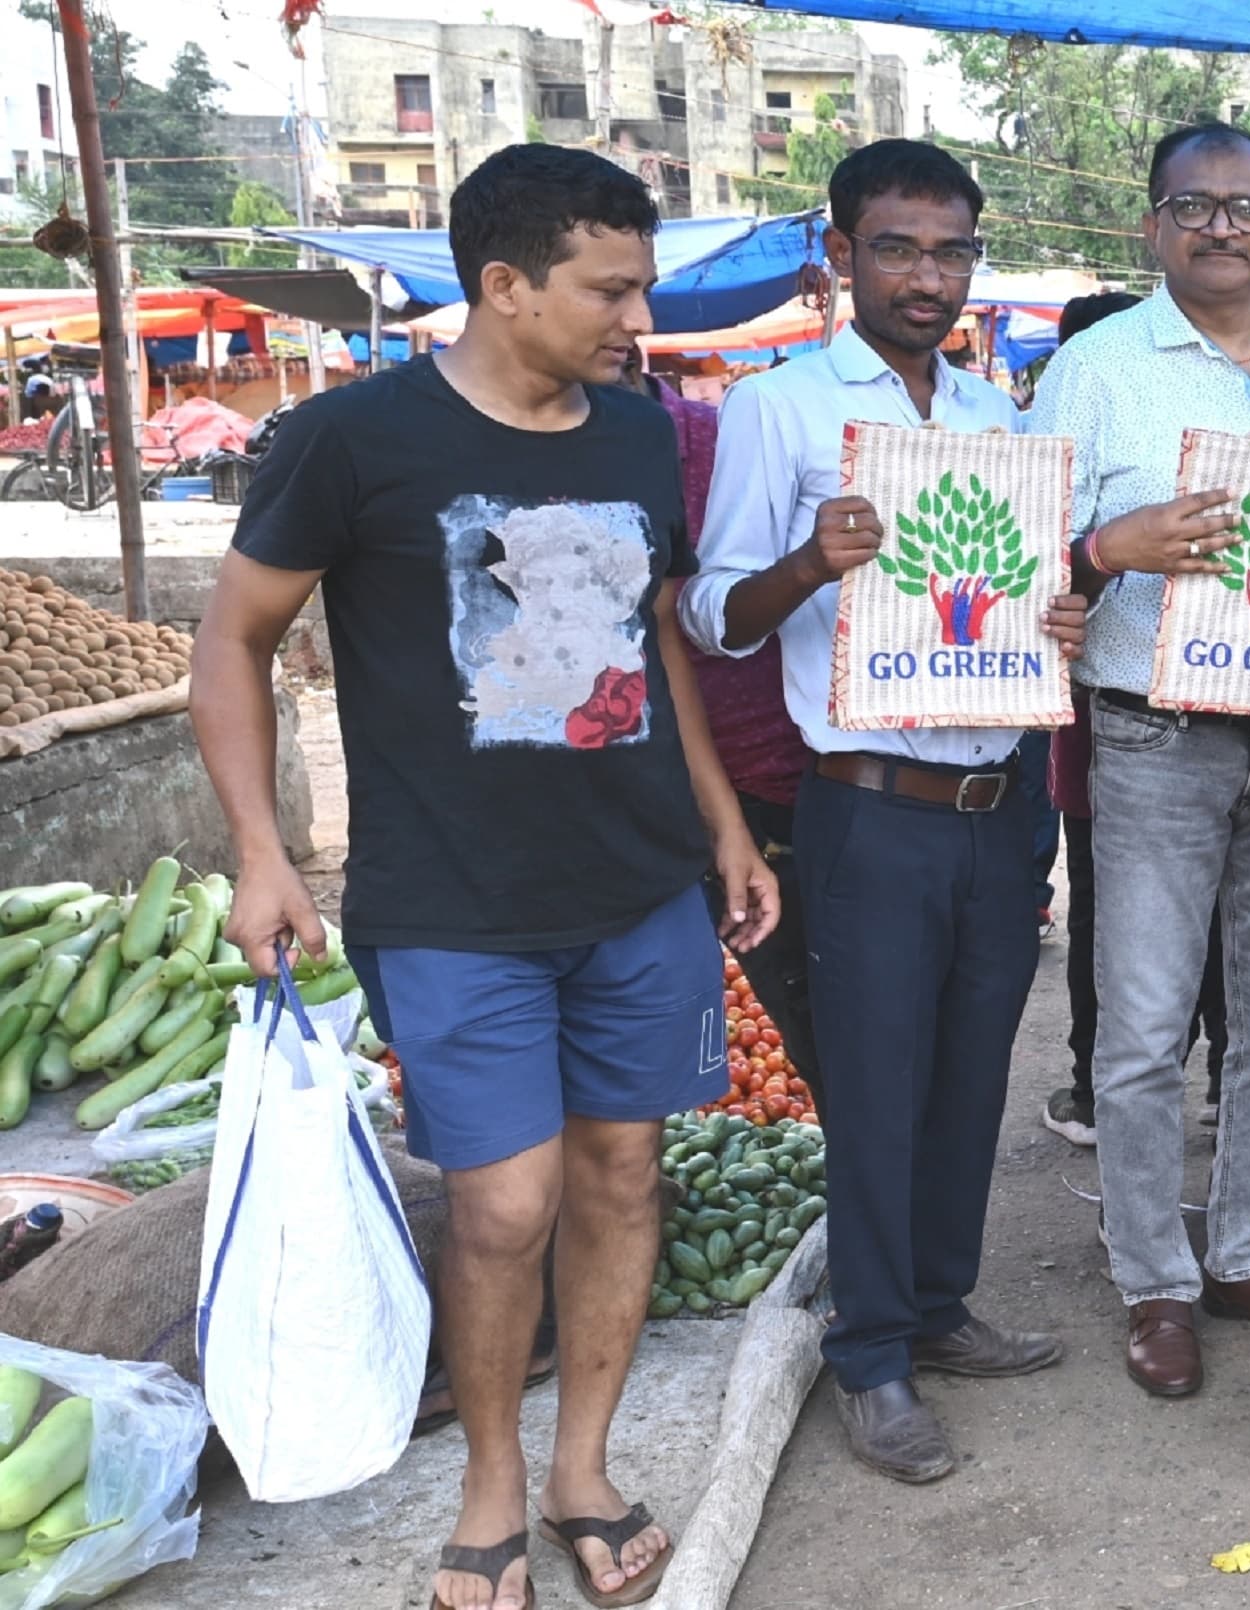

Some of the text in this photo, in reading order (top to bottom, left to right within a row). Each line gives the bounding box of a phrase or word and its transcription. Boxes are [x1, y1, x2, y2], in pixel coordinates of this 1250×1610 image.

[868, 651, 1042, 681] GO GREEN
[1183, 641, 1232, 671] GO
